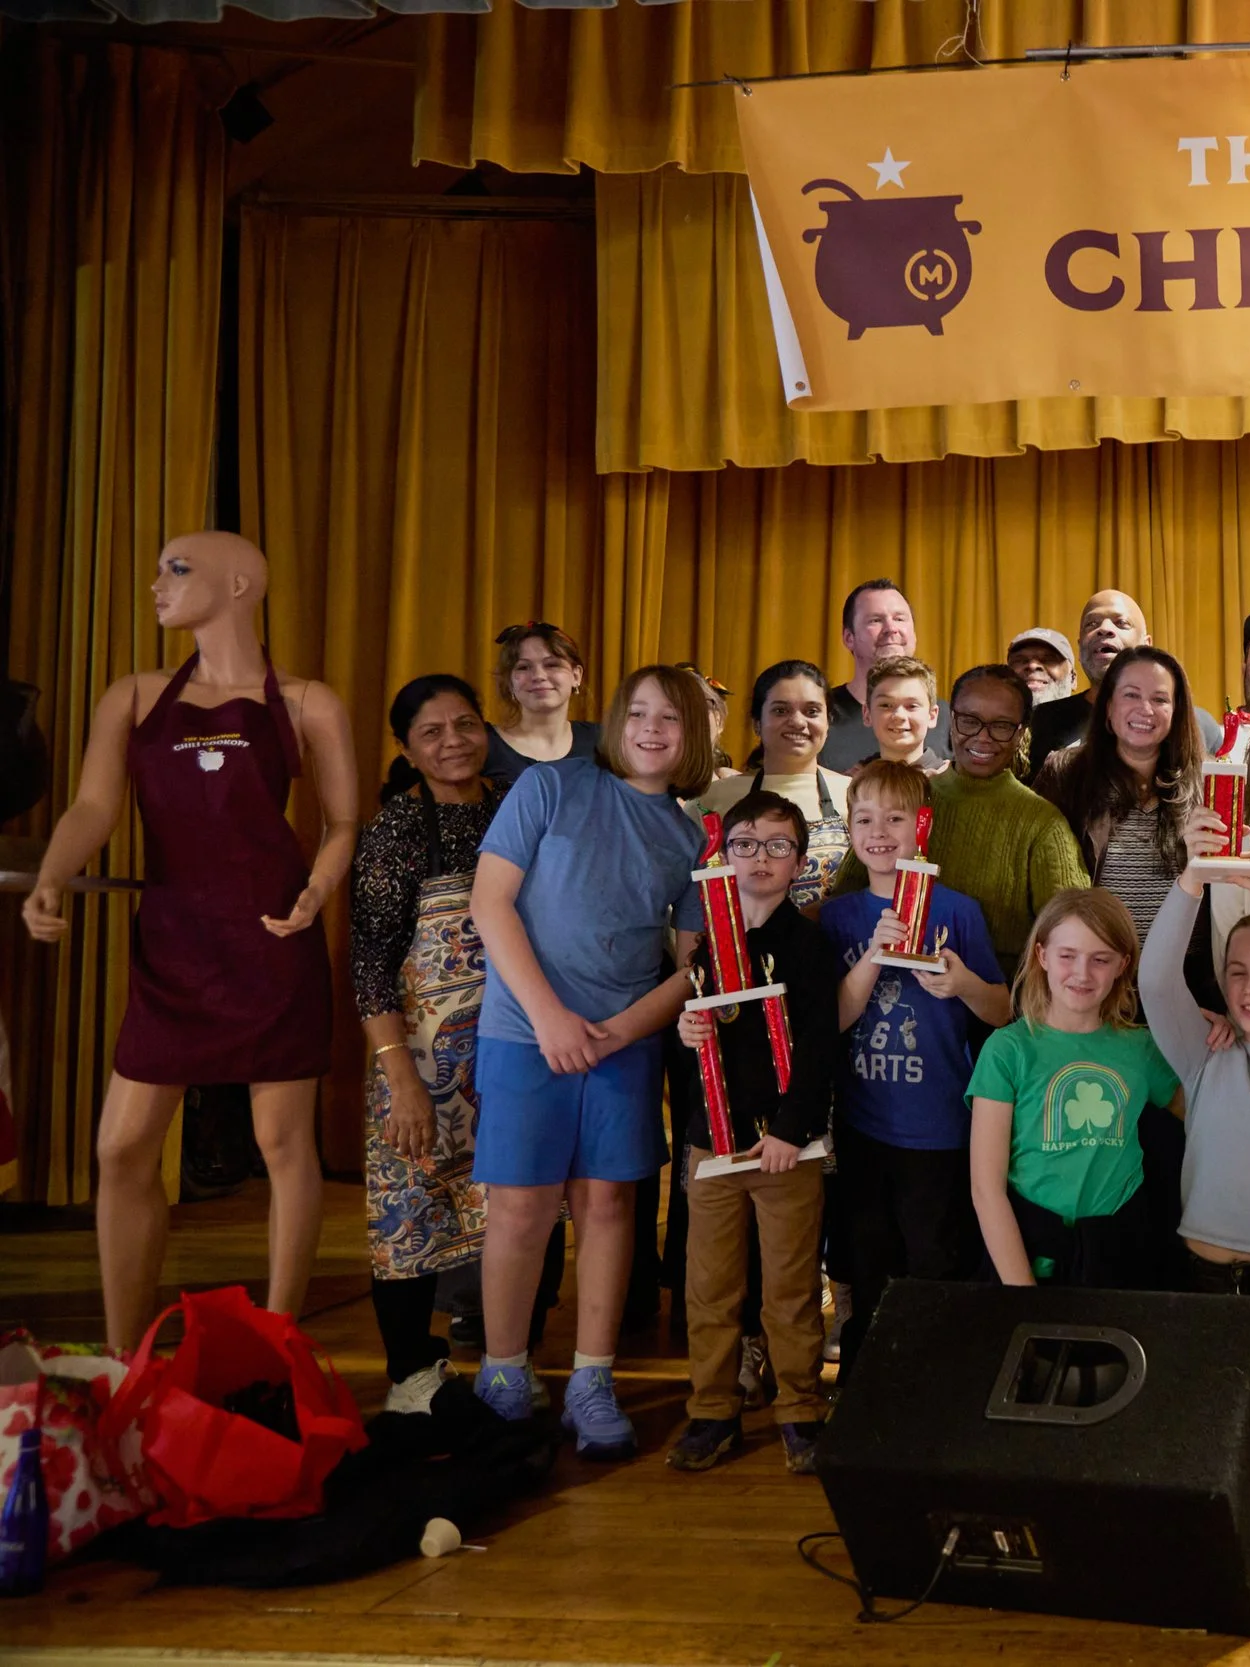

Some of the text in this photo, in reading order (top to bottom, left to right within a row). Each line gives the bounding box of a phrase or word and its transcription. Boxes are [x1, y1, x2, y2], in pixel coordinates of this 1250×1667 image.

[919, 264, 943, 286] M
[869, 1021, 892, 1050] 6
[852, 1052, 924, 1084] ARTS
[1081, 1138, 1097, 1146] GO
